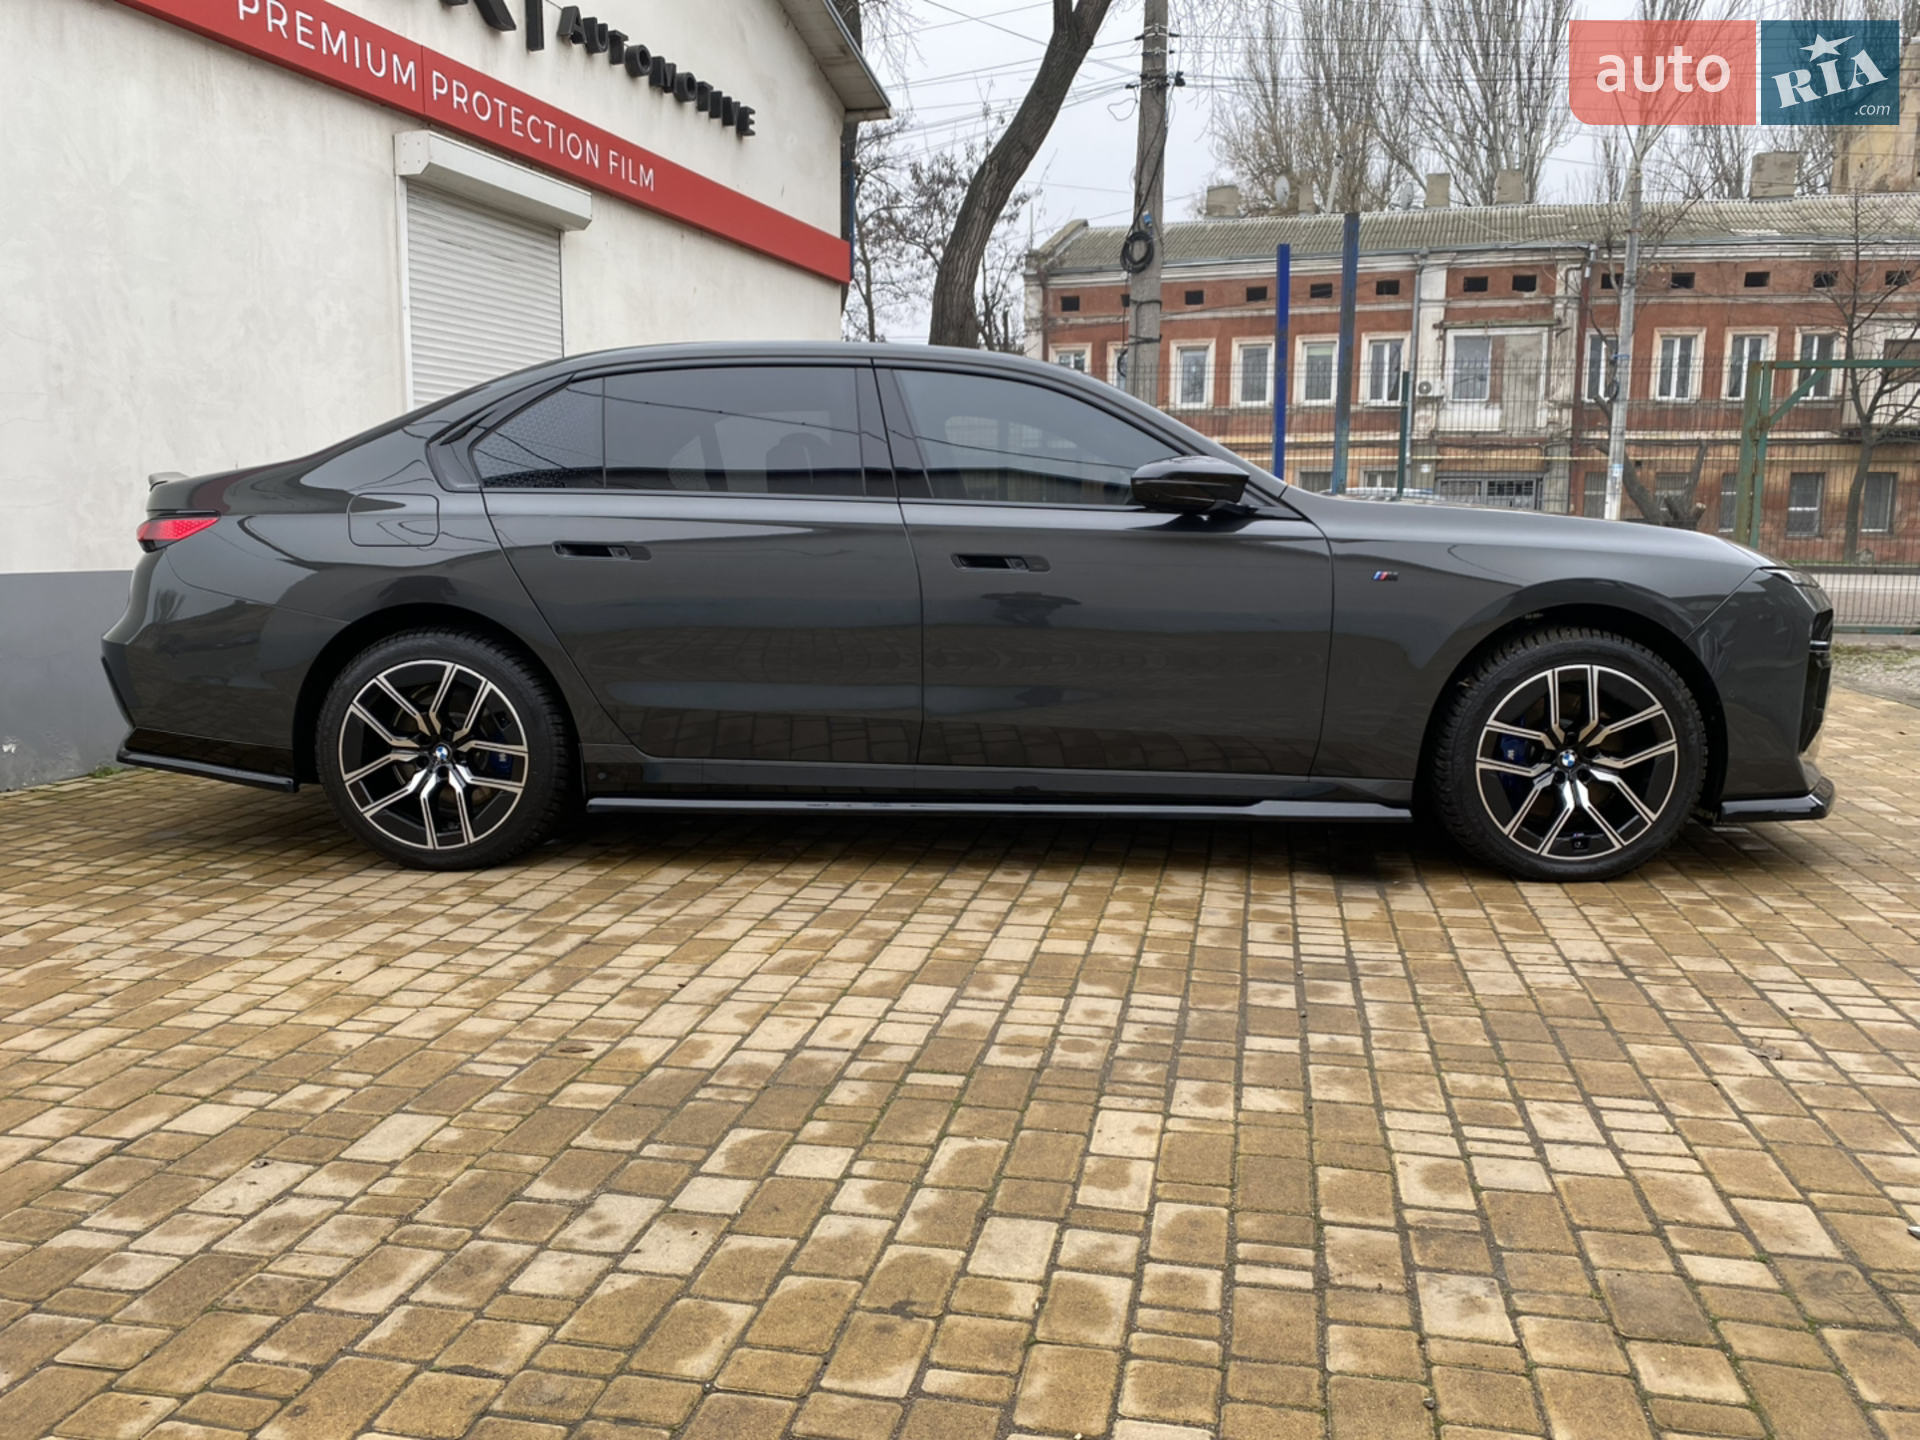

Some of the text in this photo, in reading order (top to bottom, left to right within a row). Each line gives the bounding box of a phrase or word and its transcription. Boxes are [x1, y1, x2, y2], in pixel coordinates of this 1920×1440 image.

[238, 0, 416, 92] PREMIUM
[432, 70, 599, 169] PROTECTION
[609, 149, 654, 192] FILM
[557, 5, 756, 137] AUTOMOTIVE
